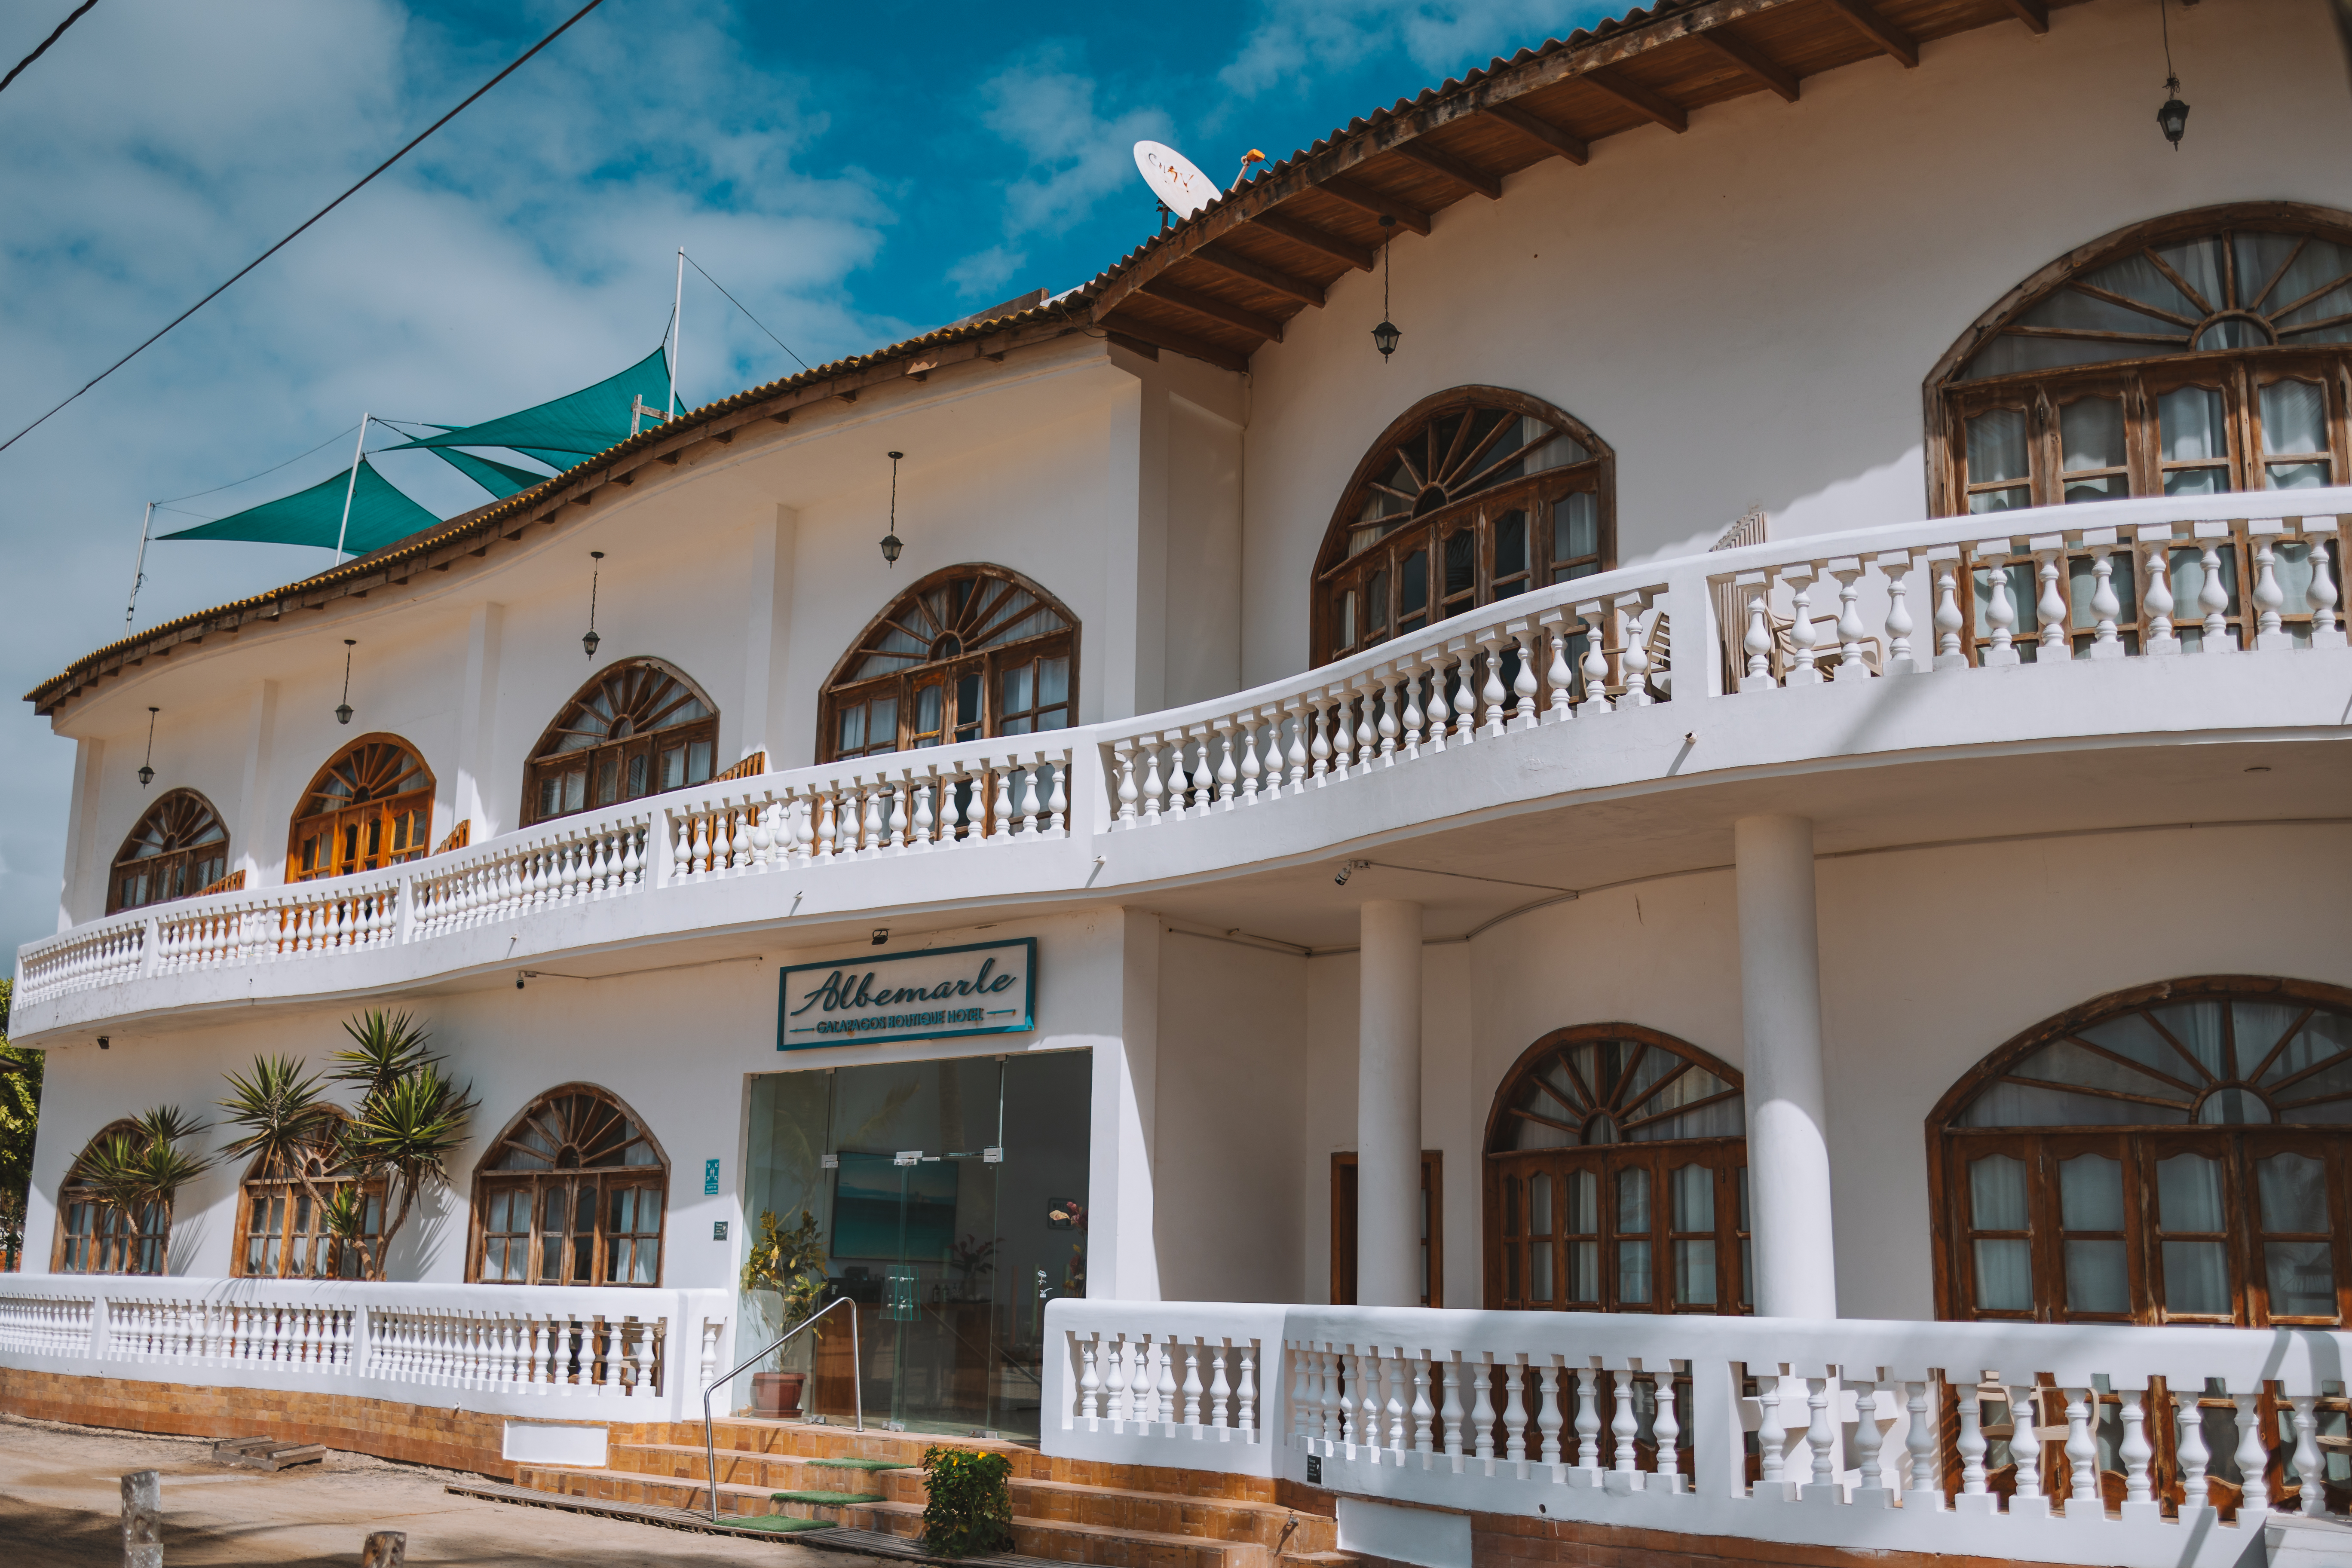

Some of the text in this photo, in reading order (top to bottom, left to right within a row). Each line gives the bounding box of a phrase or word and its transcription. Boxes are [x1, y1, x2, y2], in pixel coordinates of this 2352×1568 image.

[790, 957, 1017, 1016] Albemarle
[817, 1008, 983, 1033] GALAPAGOS BOUTIQUE HOTEL
